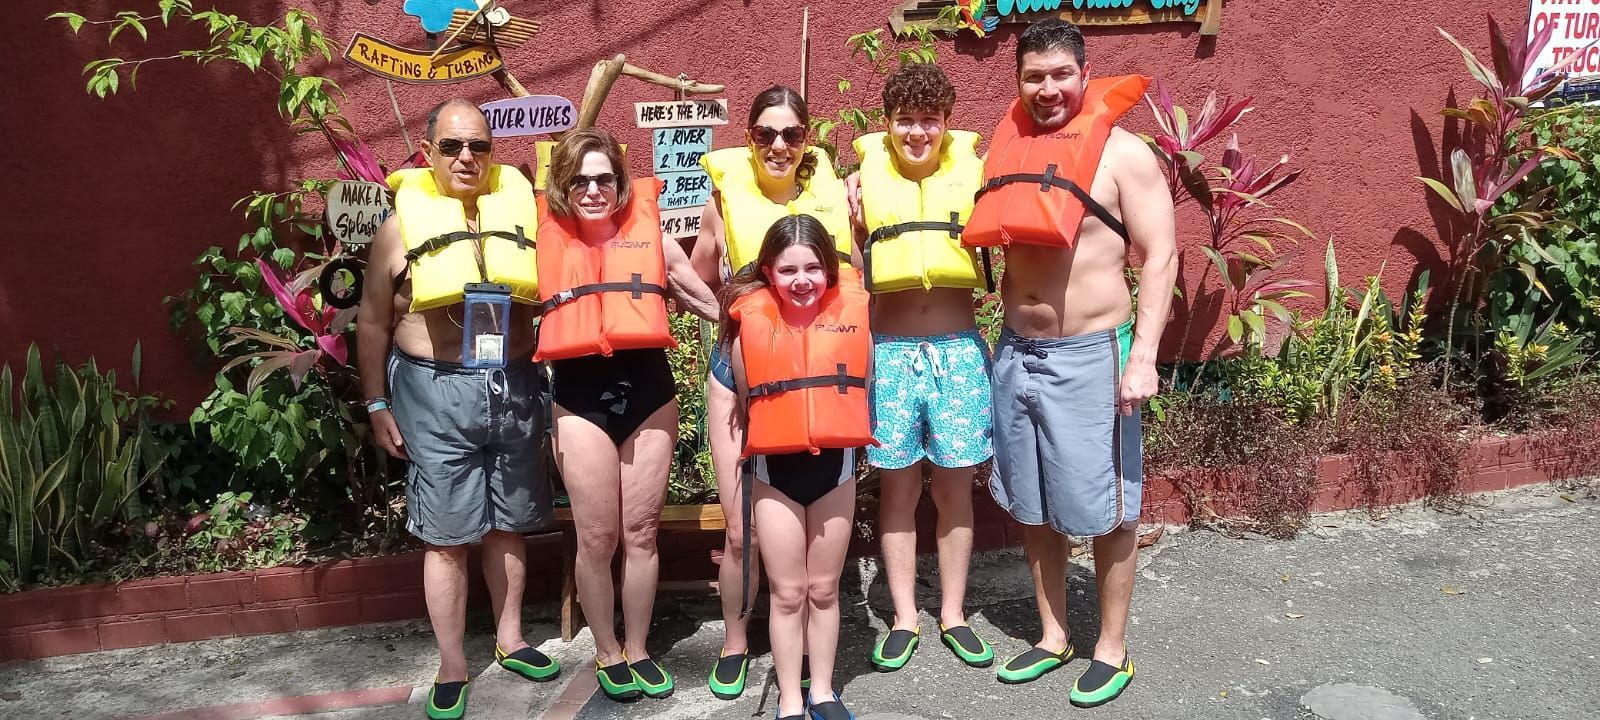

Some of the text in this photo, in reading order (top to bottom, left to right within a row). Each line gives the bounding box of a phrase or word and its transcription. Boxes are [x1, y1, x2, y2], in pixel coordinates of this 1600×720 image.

[1534, 12, 1600, 39] OF TUR
[1552, 46, 1600, 73] TRUC
[427, 65, 438, 79] &
[529, 105, 571, 128] VIBES
[641, 104, 674, 122] HERE'S
[676, 102, 693, 121] THE
[657, 128, 706, 145] 1. RIVER
[660, 153, 671, 169] 2.
[674, 175, 708, 194] BEER
[341, 183, 382, 207] MAKE A
[691, 194, 700, 204] IT
[335, 211, 378, 240] Splash
[684, 215, 701, 233] THE
